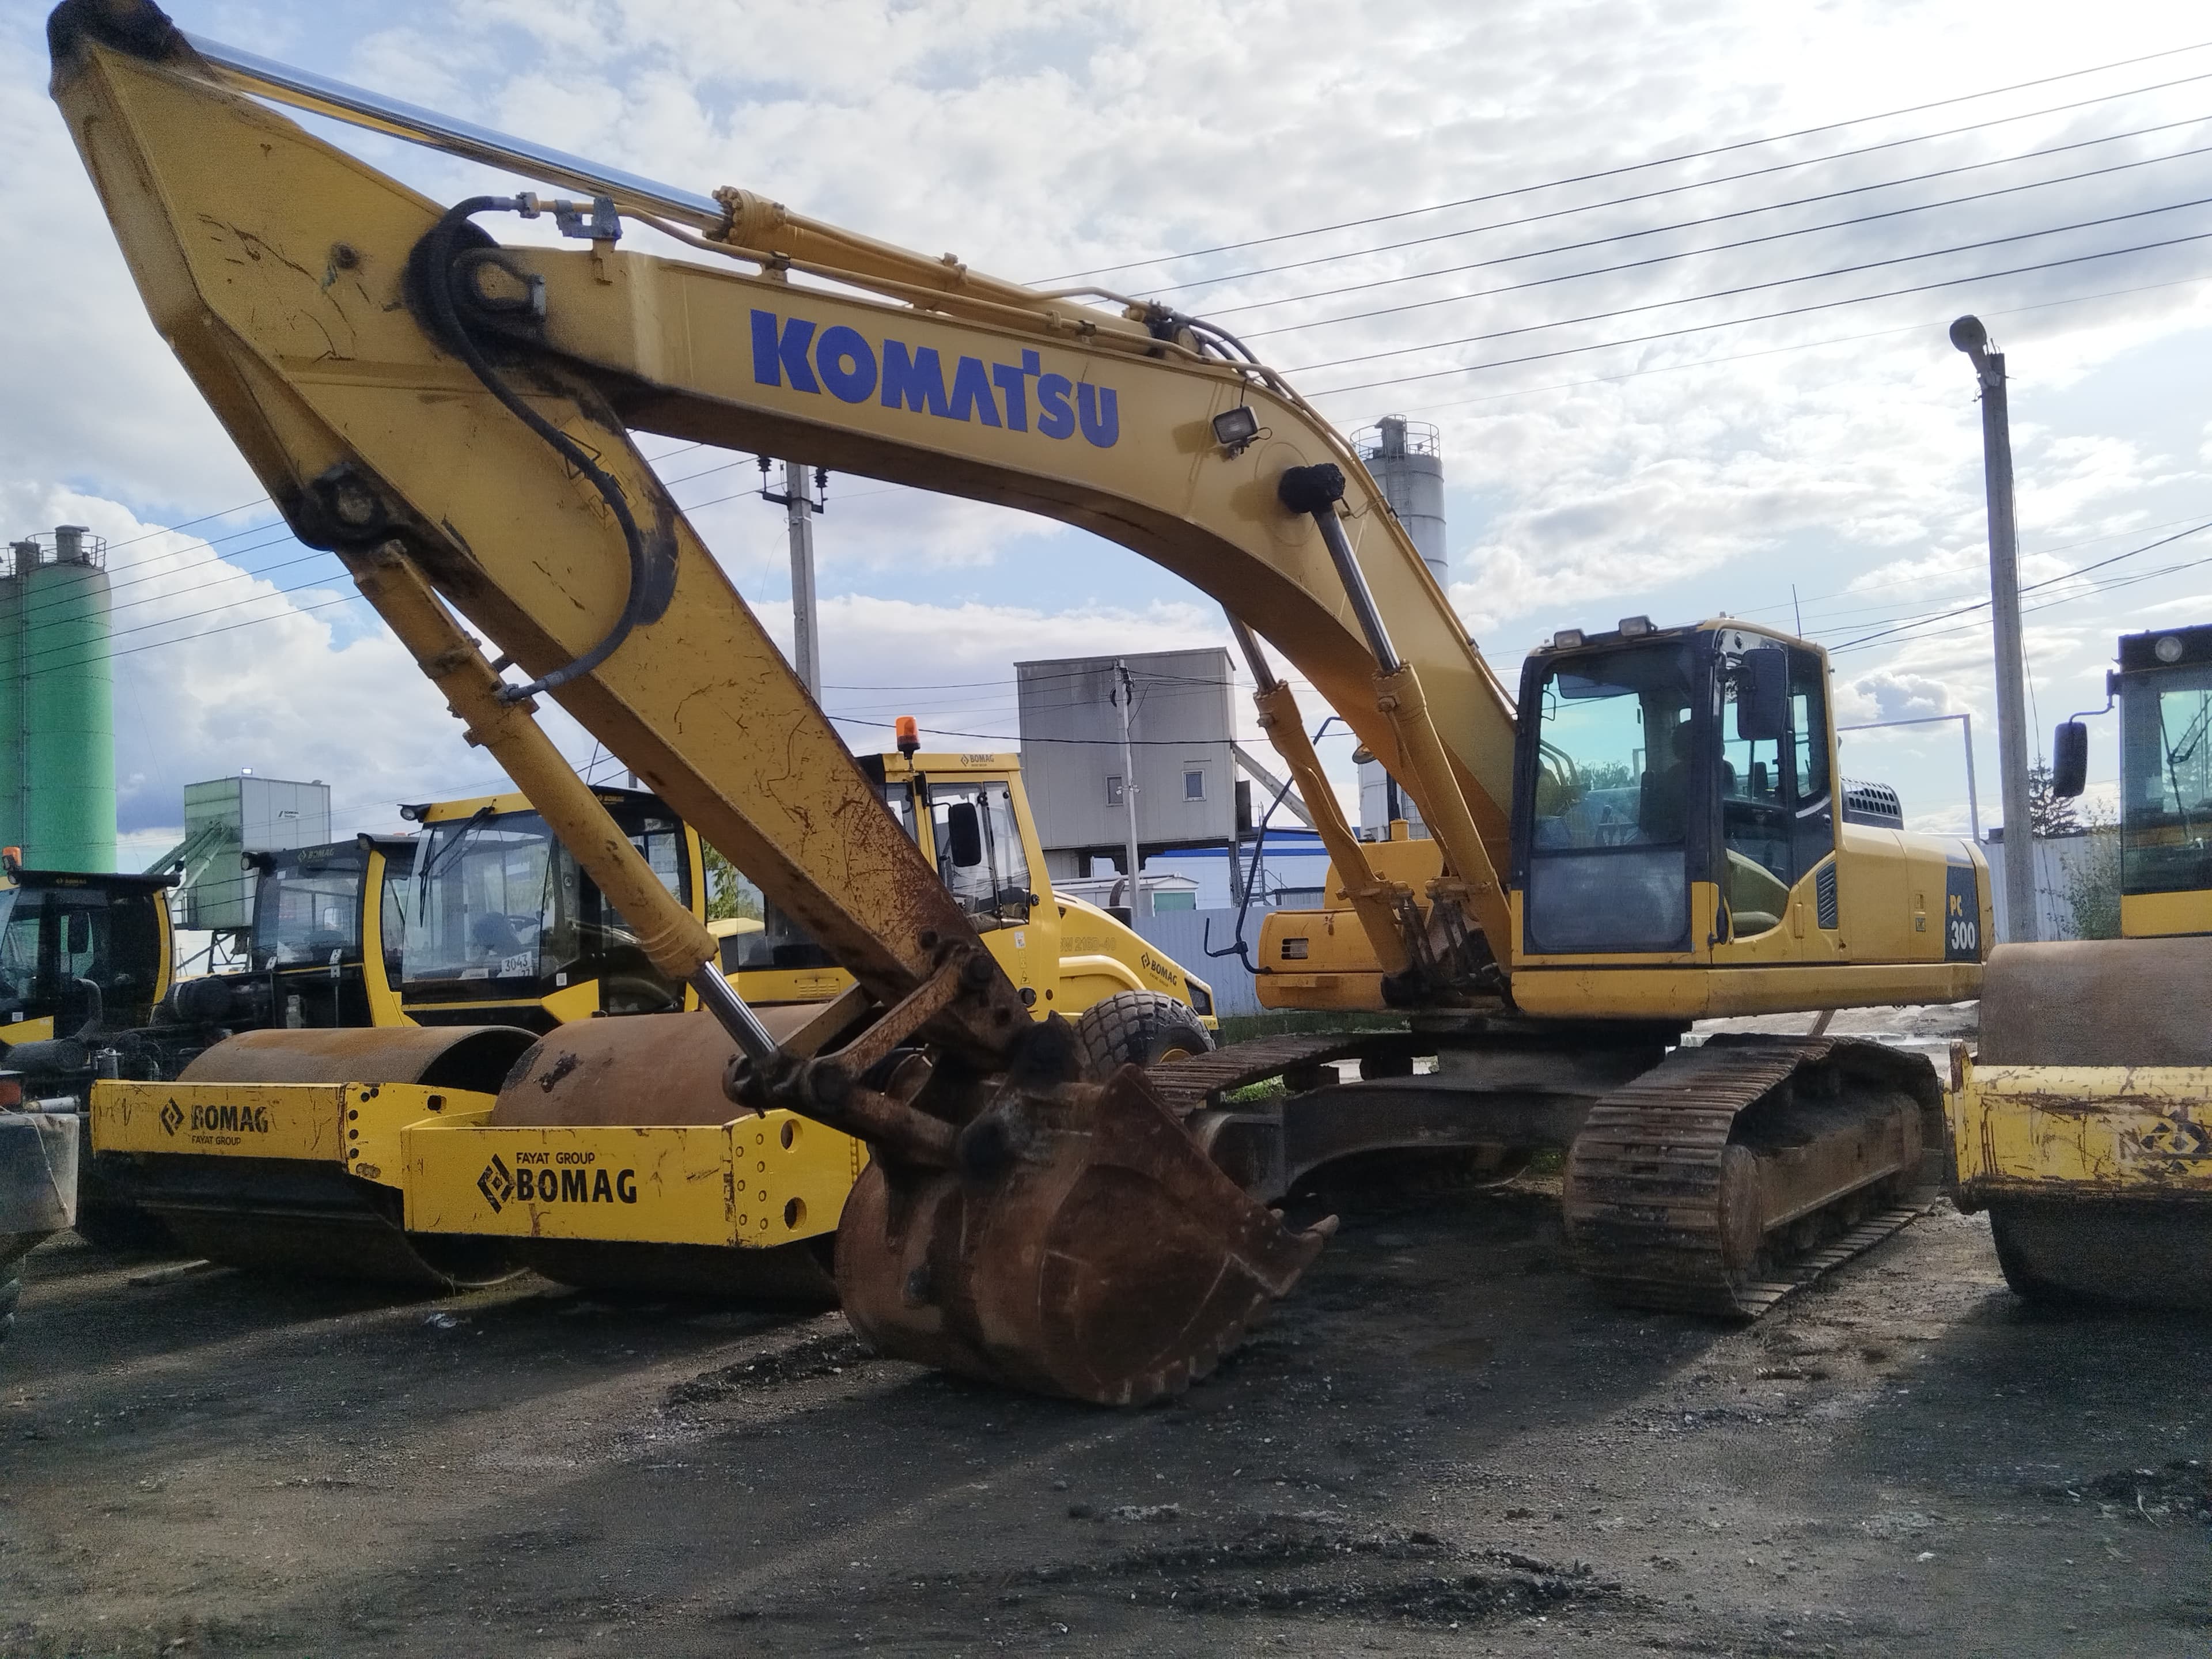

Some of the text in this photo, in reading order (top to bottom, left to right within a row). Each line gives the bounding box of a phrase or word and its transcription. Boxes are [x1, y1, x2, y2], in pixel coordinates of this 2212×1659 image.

[751, 309, 1119, 448] KOMATSU
[970, 755, 994, 763] BOMAG
[308, 848, 334, 859] BOMAG
[1949, 895, 1963, 916] PC
[1951, 921, 1975, 950] 300
[505, 955, 528, 972] 3043
[1151, 959, 1177, 986] BOMAG
[191, 1105, 268, 1132] BOMAG
[192, 1135, 241, 1145] FAYAT GROUP
[516, 1152, 595, 1164] FAYAT GROUP
[516, 1168, 637, 1203] BOMAG
